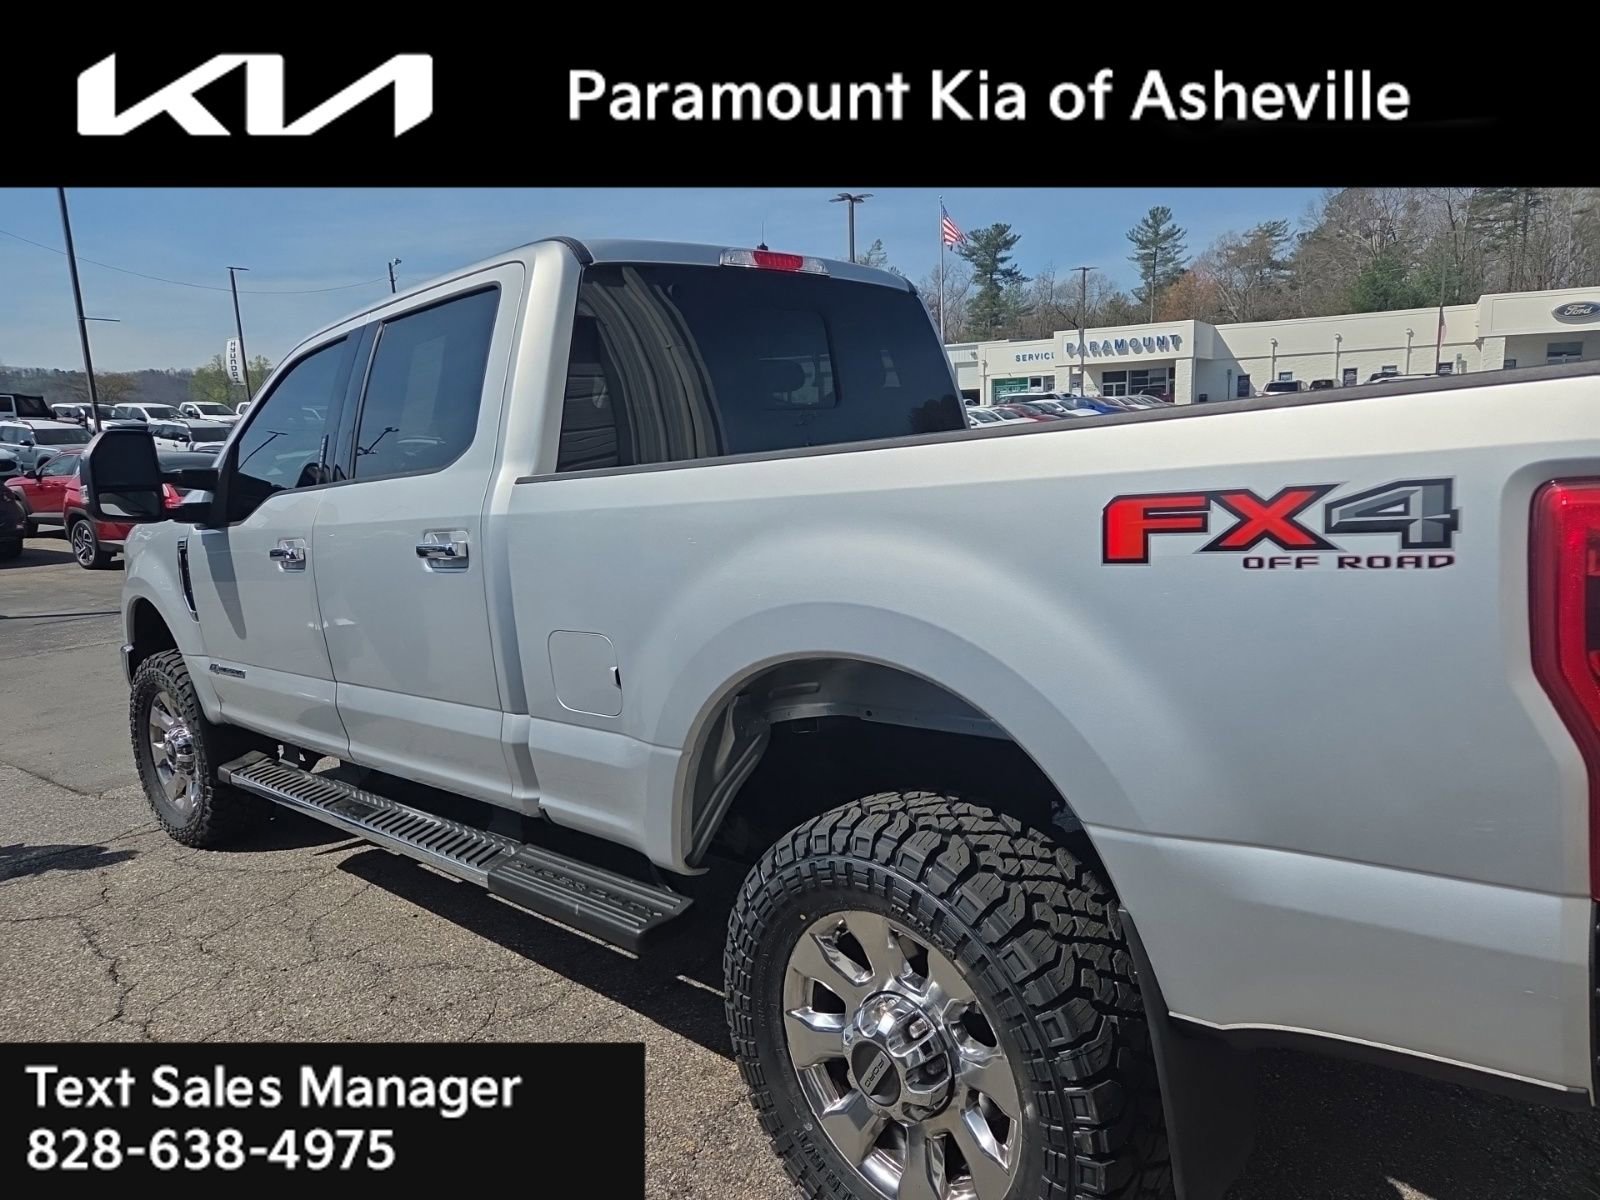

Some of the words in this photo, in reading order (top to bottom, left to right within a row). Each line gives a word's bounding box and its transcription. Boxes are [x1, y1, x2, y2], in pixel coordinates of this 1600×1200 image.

[1564, 304, 1593, 316] Ford
[1102, 477, 1460, 565] FX4
[1242, 555, 1320, 570] OFF
[1336, 554, 1455, 570] ROAD
[864, 1058, 885, 1089] FORD
